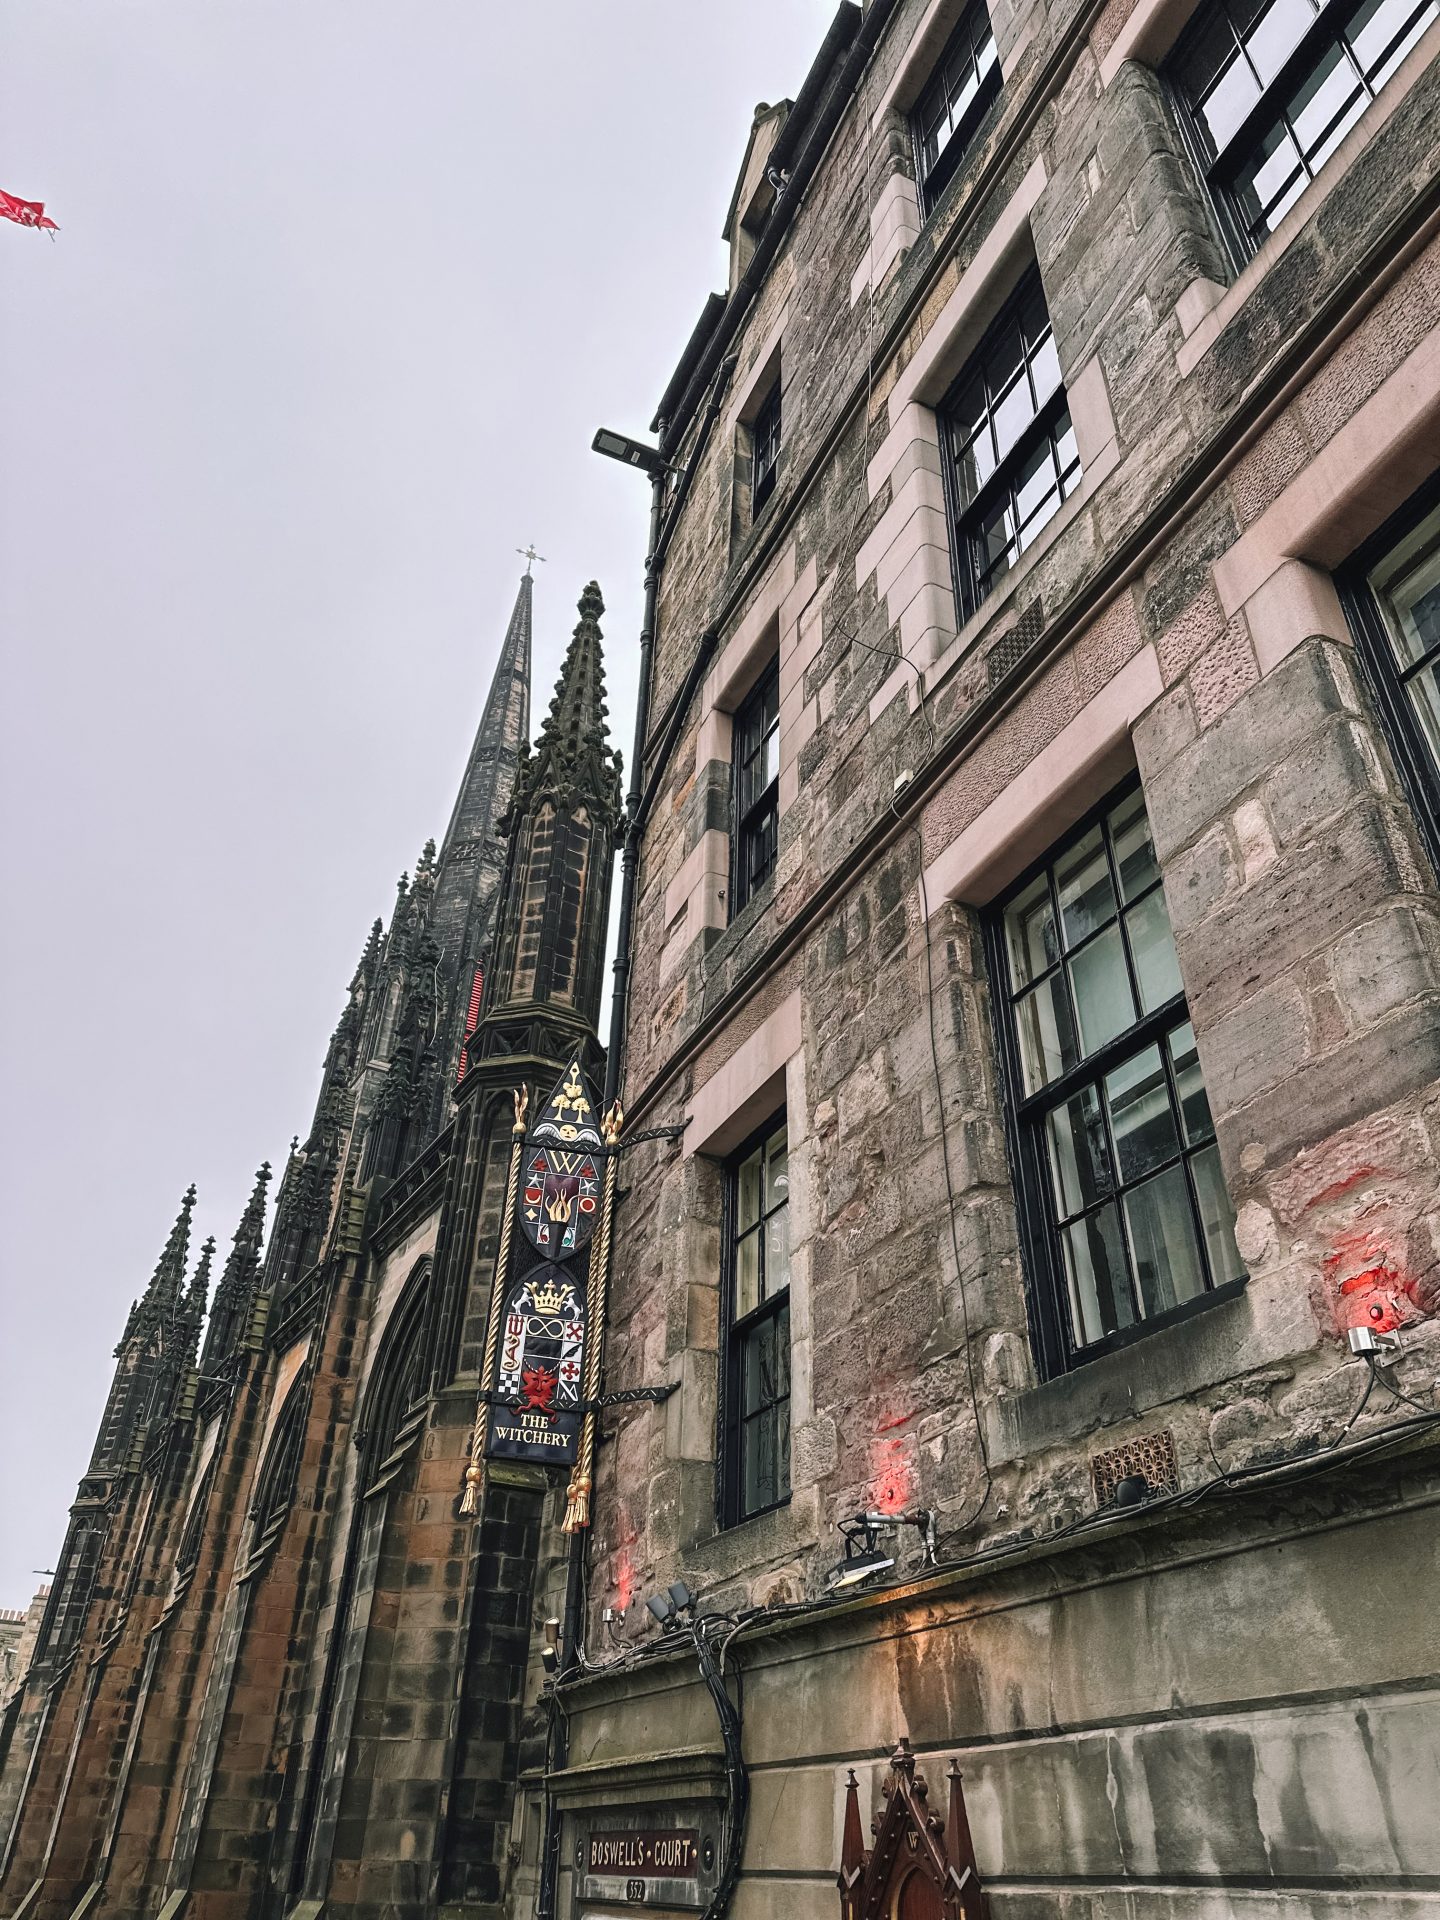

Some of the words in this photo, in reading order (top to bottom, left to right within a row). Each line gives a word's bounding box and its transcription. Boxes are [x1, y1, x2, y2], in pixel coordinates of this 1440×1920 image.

[547, 1149, 584, 1175] W
[520, 1413, 549, 1429] THE
[495, 1426, 571, 1447] WITCHERY
[591, 1837, 644, 1866] BOSWELL'S
[654, 1839, 691, 1867] COURT
[629, 1881, 643, 1899] 352
